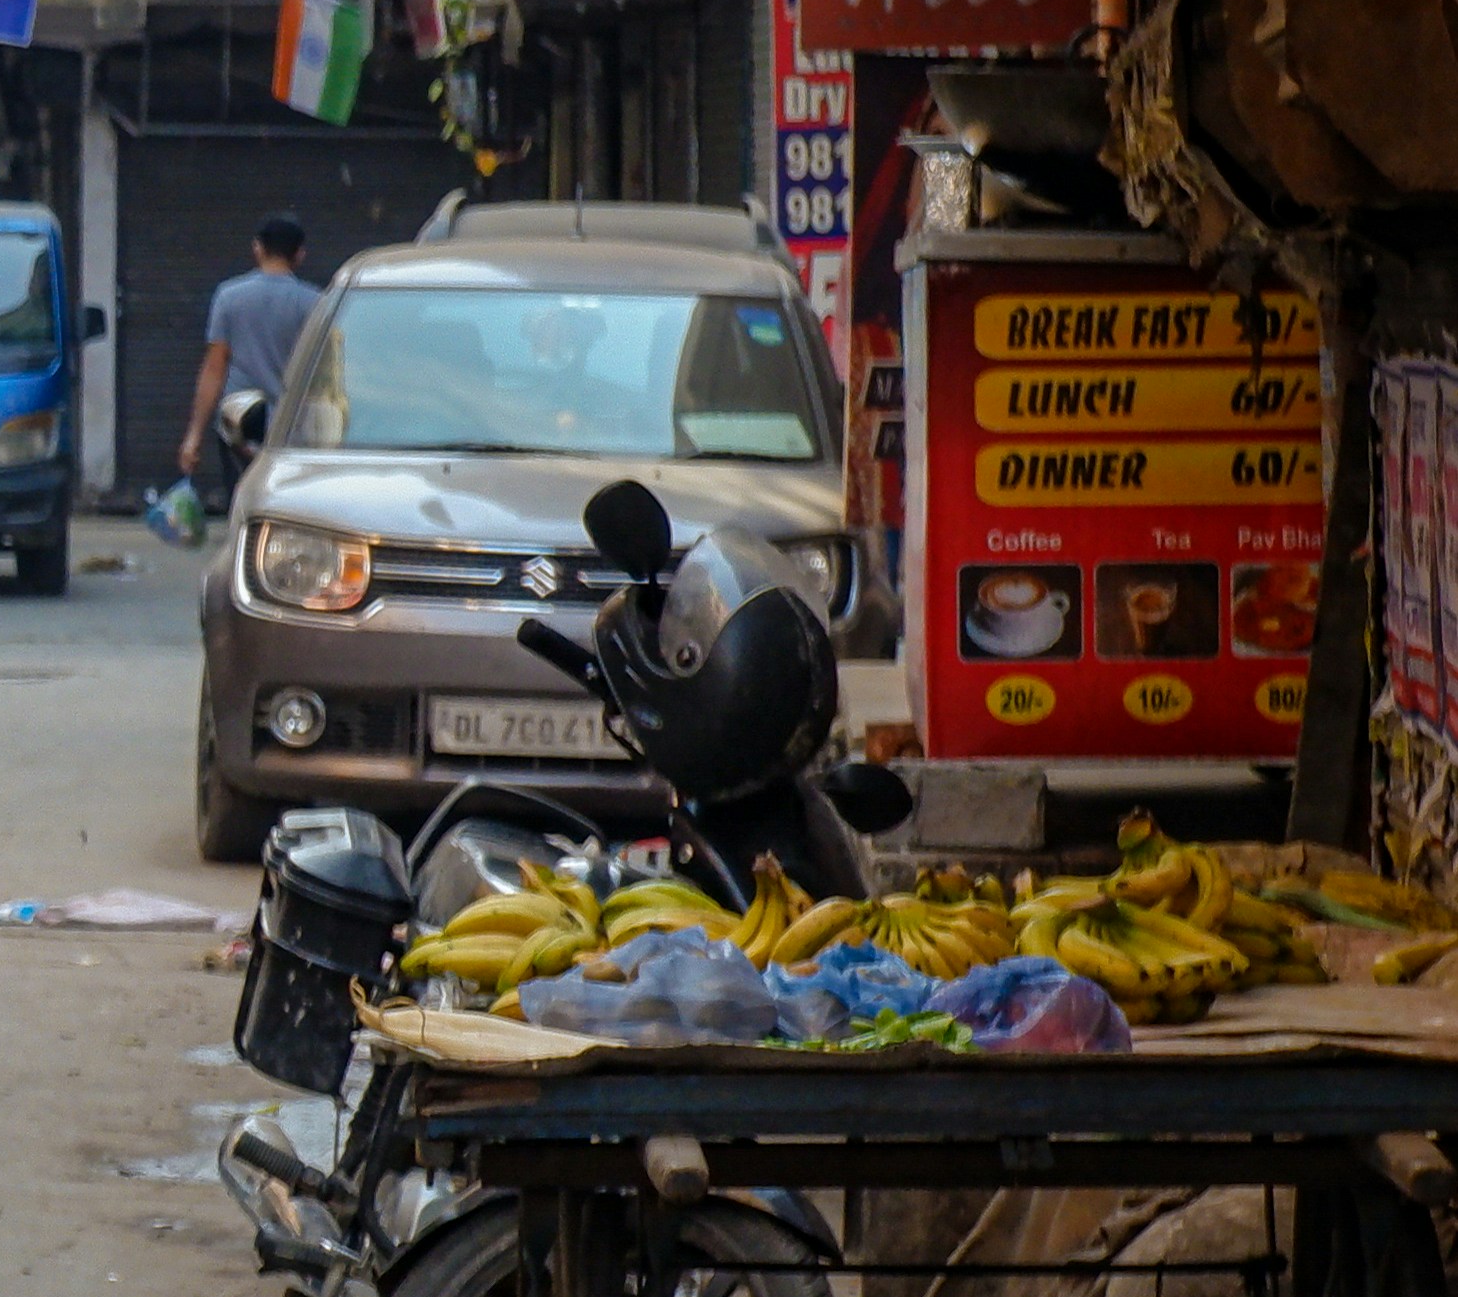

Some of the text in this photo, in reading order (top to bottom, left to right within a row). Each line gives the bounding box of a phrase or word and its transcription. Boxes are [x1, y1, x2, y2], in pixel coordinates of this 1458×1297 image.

[784, 77, 847, 125] Dry
[1007, 307, 1117, 350] BREAK
[1131, 304, 1211, 350] FAST
[1007, 378, 1318, 419] LUNCH 60/-
[997, 449, 1318, 491] DINNER 60/-
[986, 528, 1064, 553] Coffee
[1151, 528, 1192, 552] Tea
[1237, 526, 1276, 553] Pav
[454, 714, 487, 744] DL
